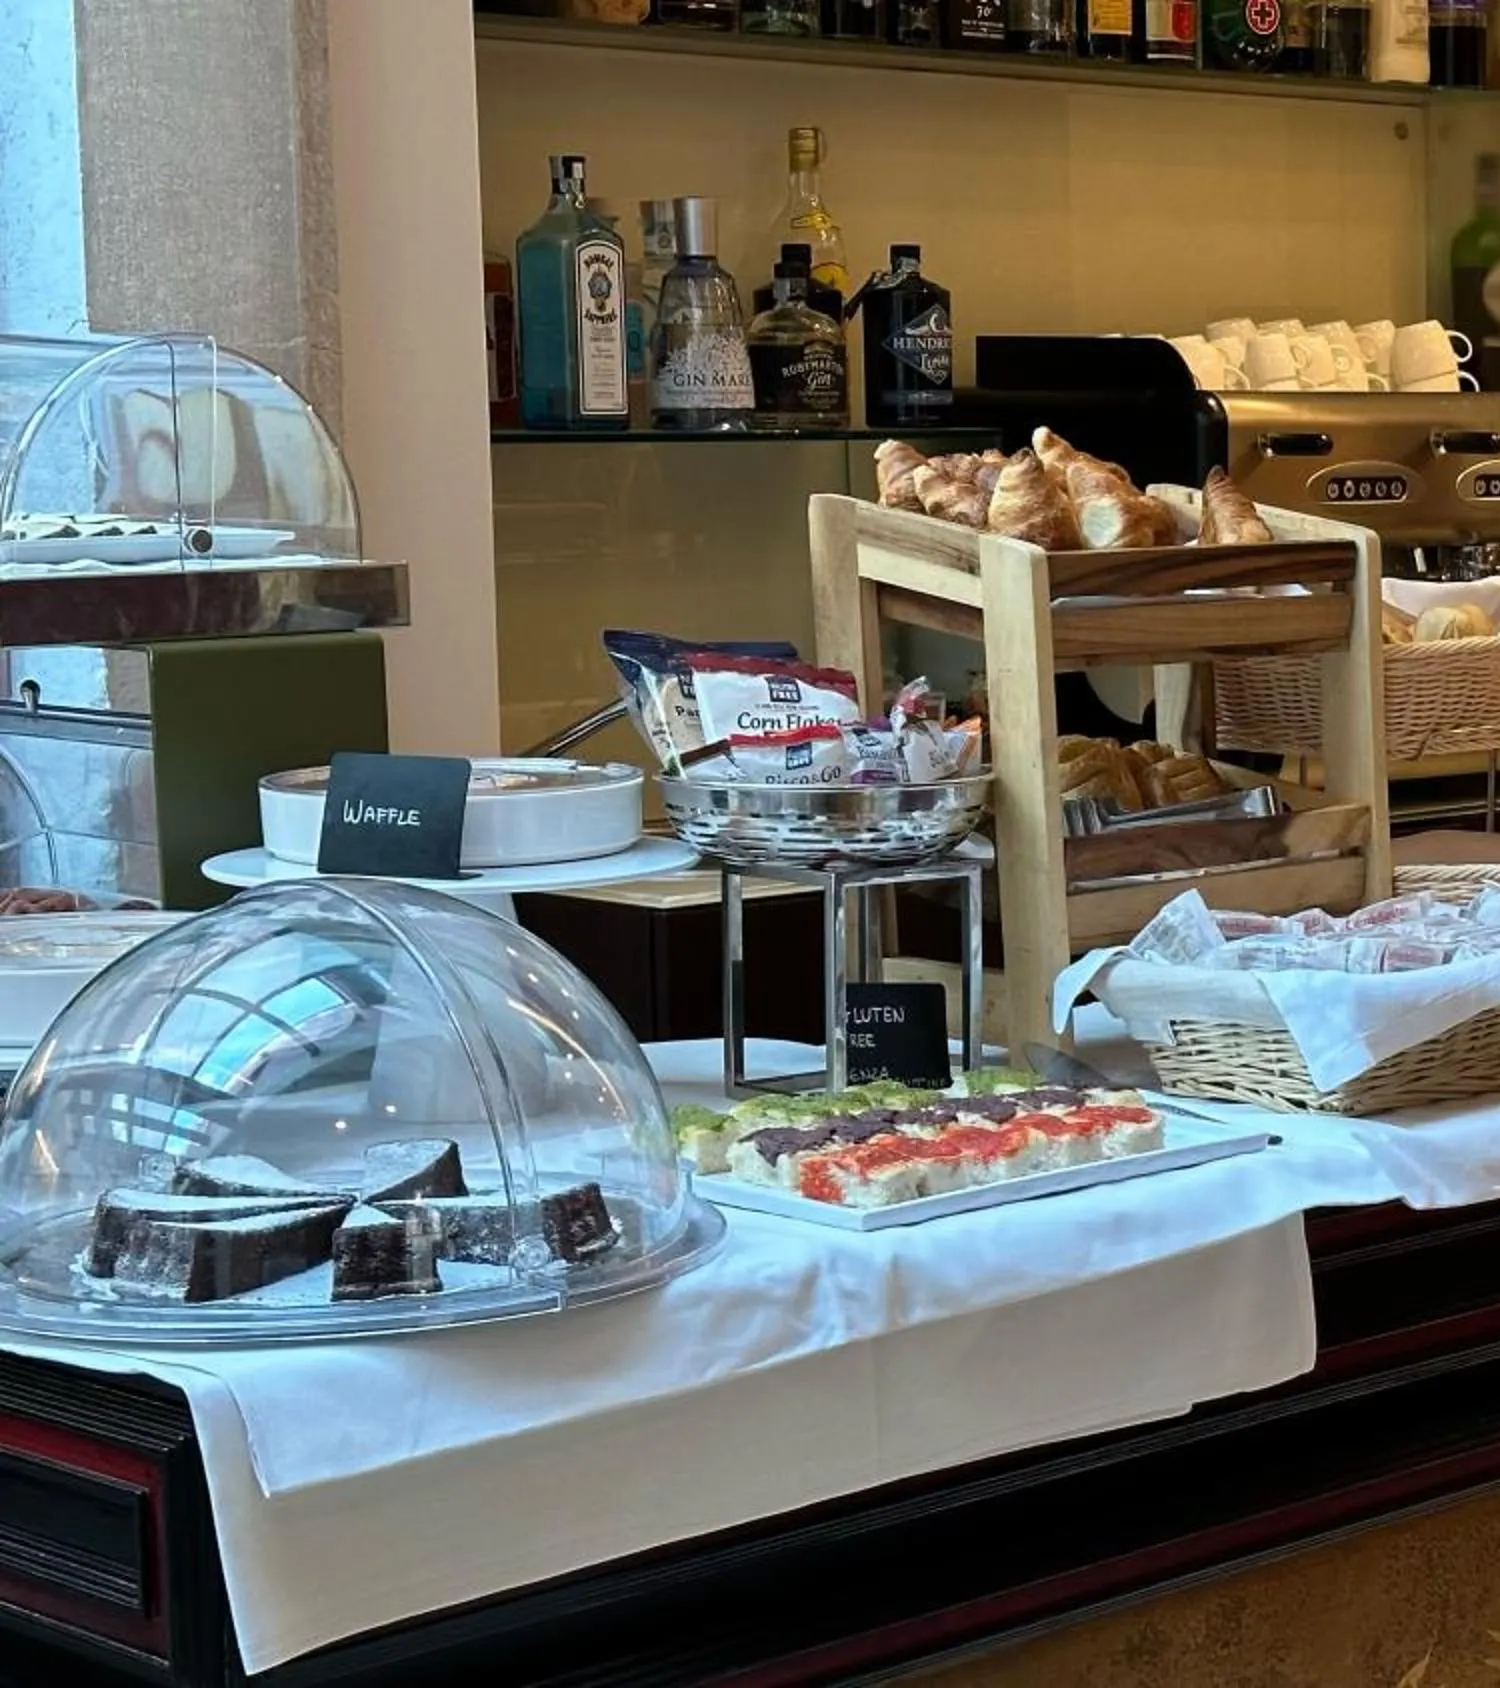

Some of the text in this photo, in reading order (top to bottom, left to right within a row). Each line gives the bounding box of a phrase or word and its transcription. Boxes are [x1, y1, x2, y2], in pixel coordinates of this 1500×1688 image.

[673, 372, 706, 387] GIN
[736, 711, 782, 730] Corn
[342, 799, 422, 827] WAFFLE
[846, 1005, 905, 1024] LUTEN
[849, 1066, 890, 1082] ENZA
